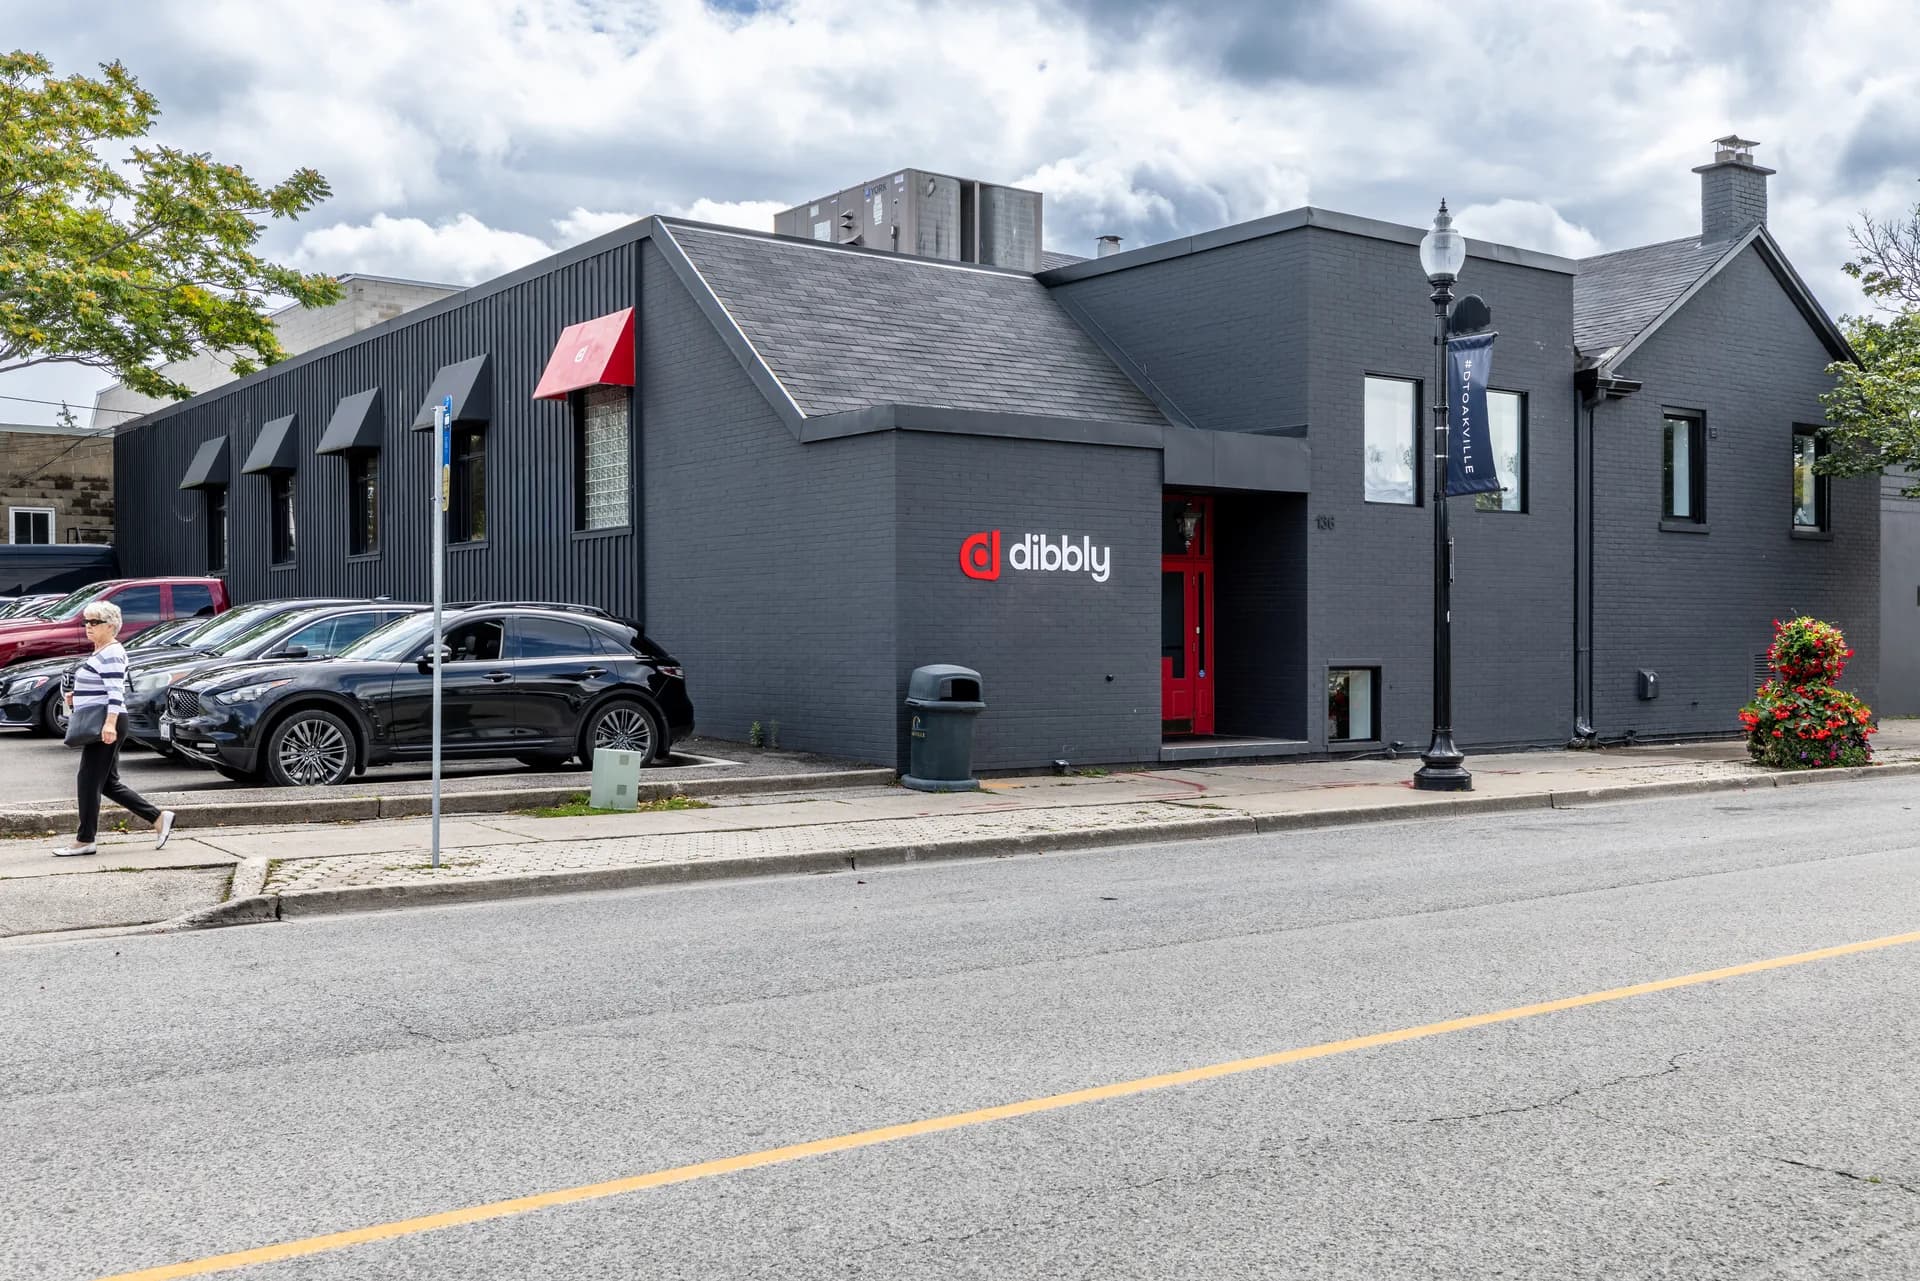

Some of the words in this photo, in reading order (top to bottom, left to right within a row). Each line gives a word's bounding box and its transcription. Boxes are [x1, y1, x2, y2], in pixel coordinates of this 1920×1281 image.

[1461, 359, 1475, 474] #DTOAKVILLE
[1315, 514, 1335, 530] 136
[1009, 533, 1111, 583] dibbly
